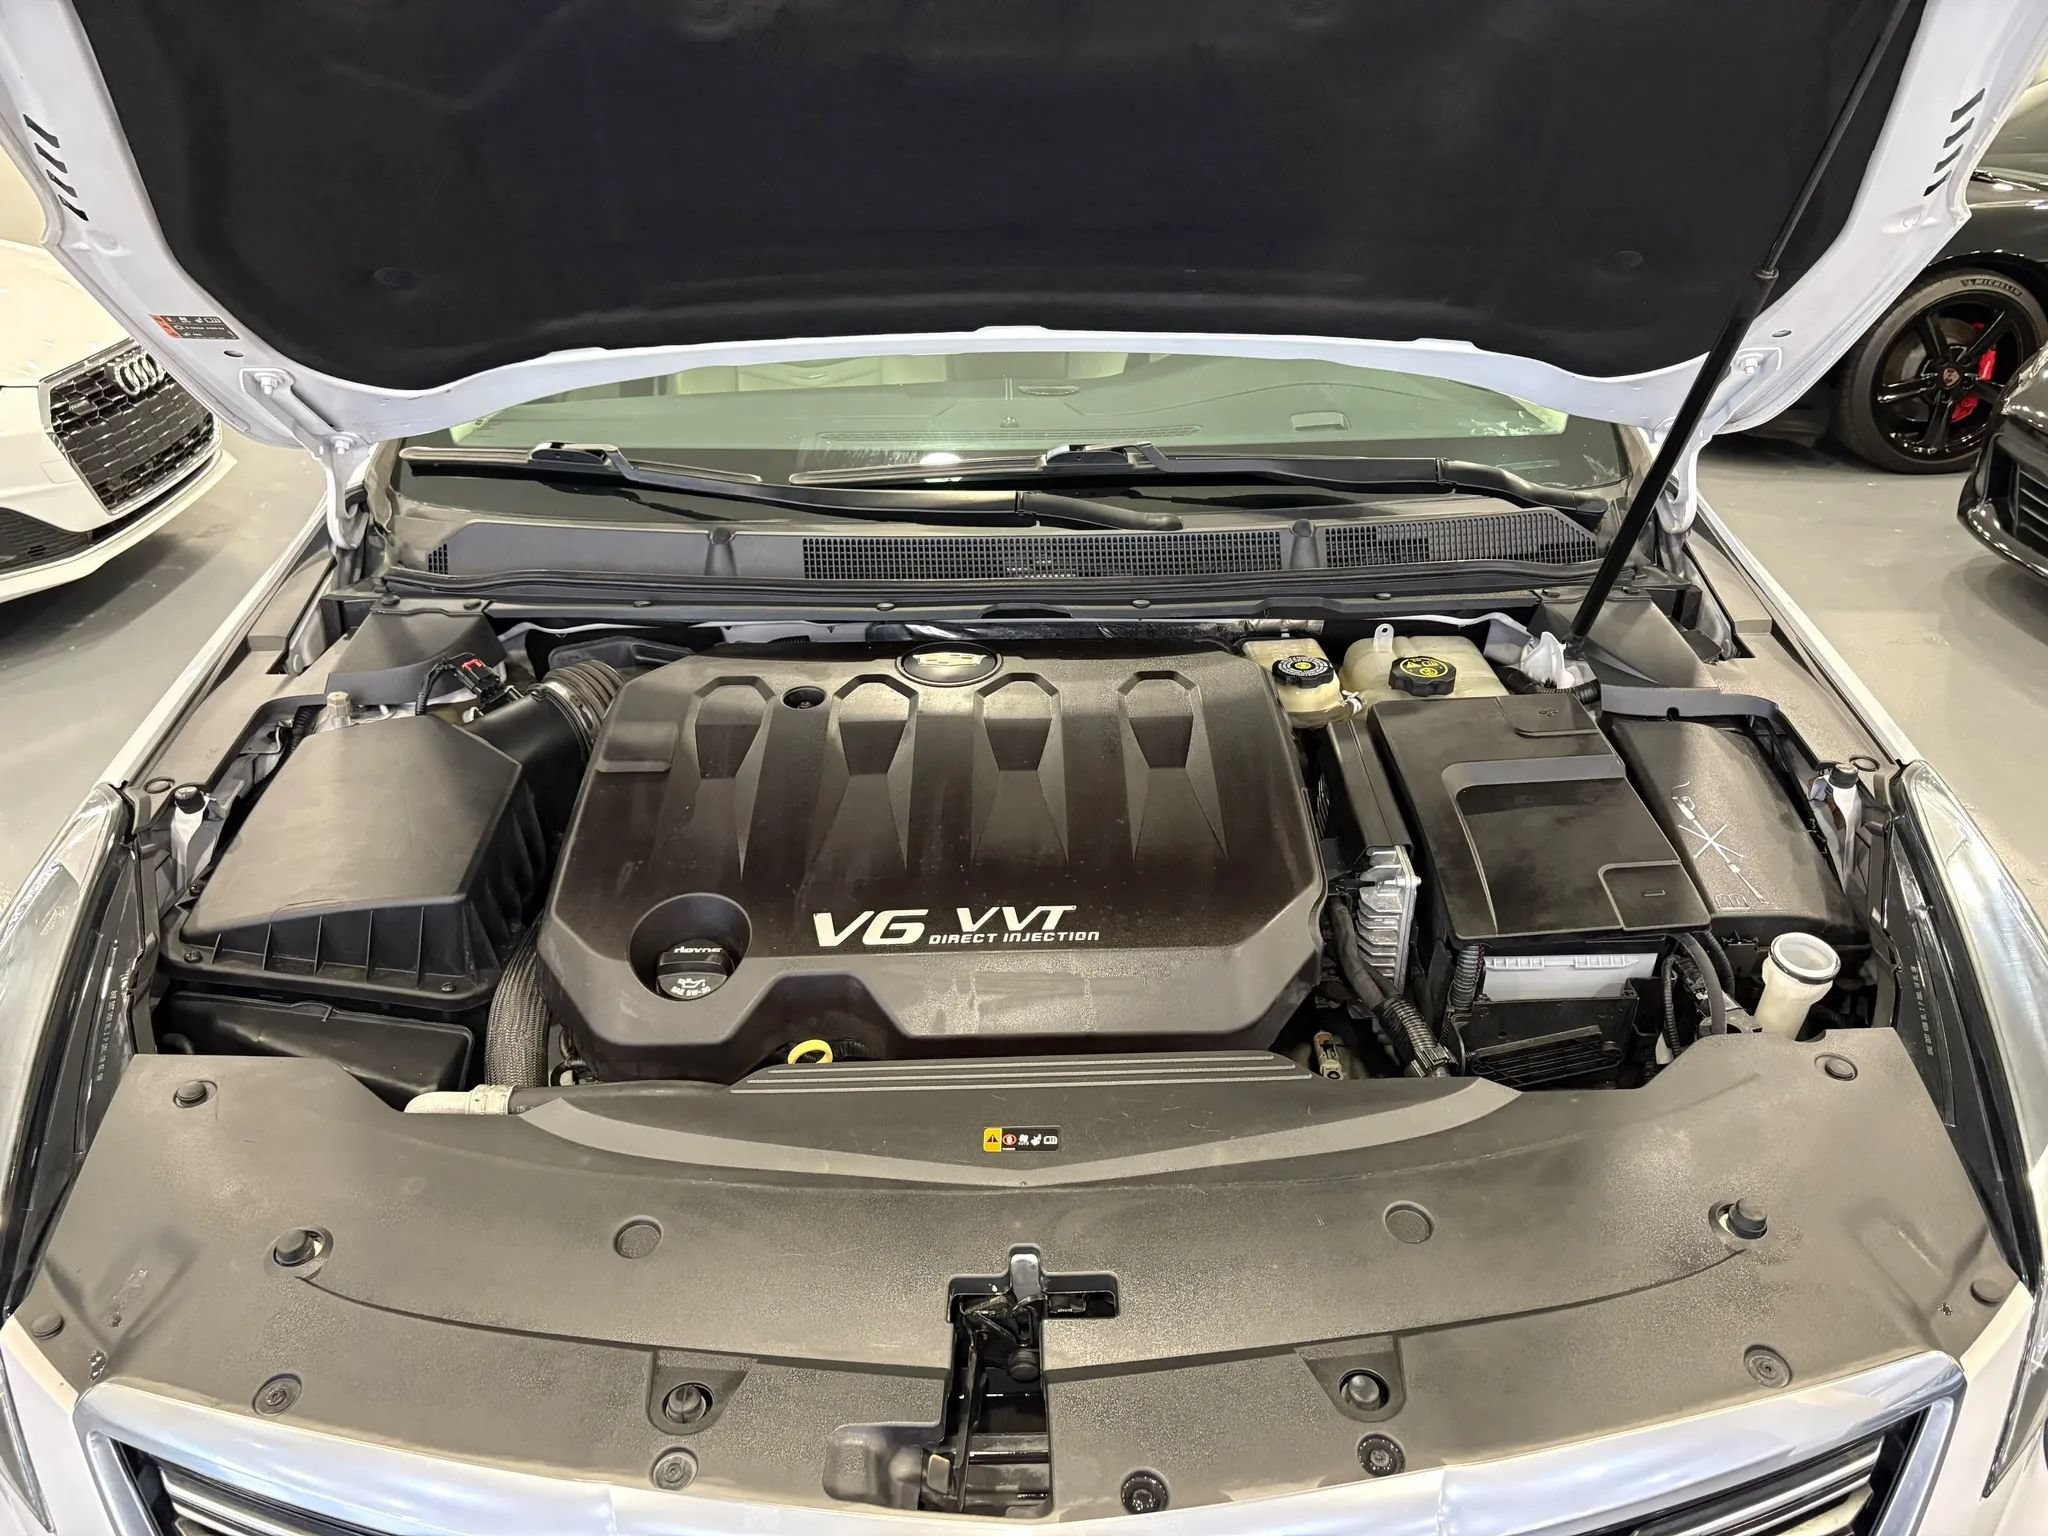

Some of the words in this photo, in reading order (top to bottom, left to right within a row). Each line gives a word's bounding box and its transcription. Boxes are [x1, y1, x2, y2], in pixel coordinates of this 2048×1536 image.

[1974, 278, 2023, 297] MICHELIN
[813, 909, 929, 947] V6
[956, 905, 1077, 932] VVT
[928, 933, 998, 945] DIRECT
[1002, 931, 1100, 943] INJECTION
